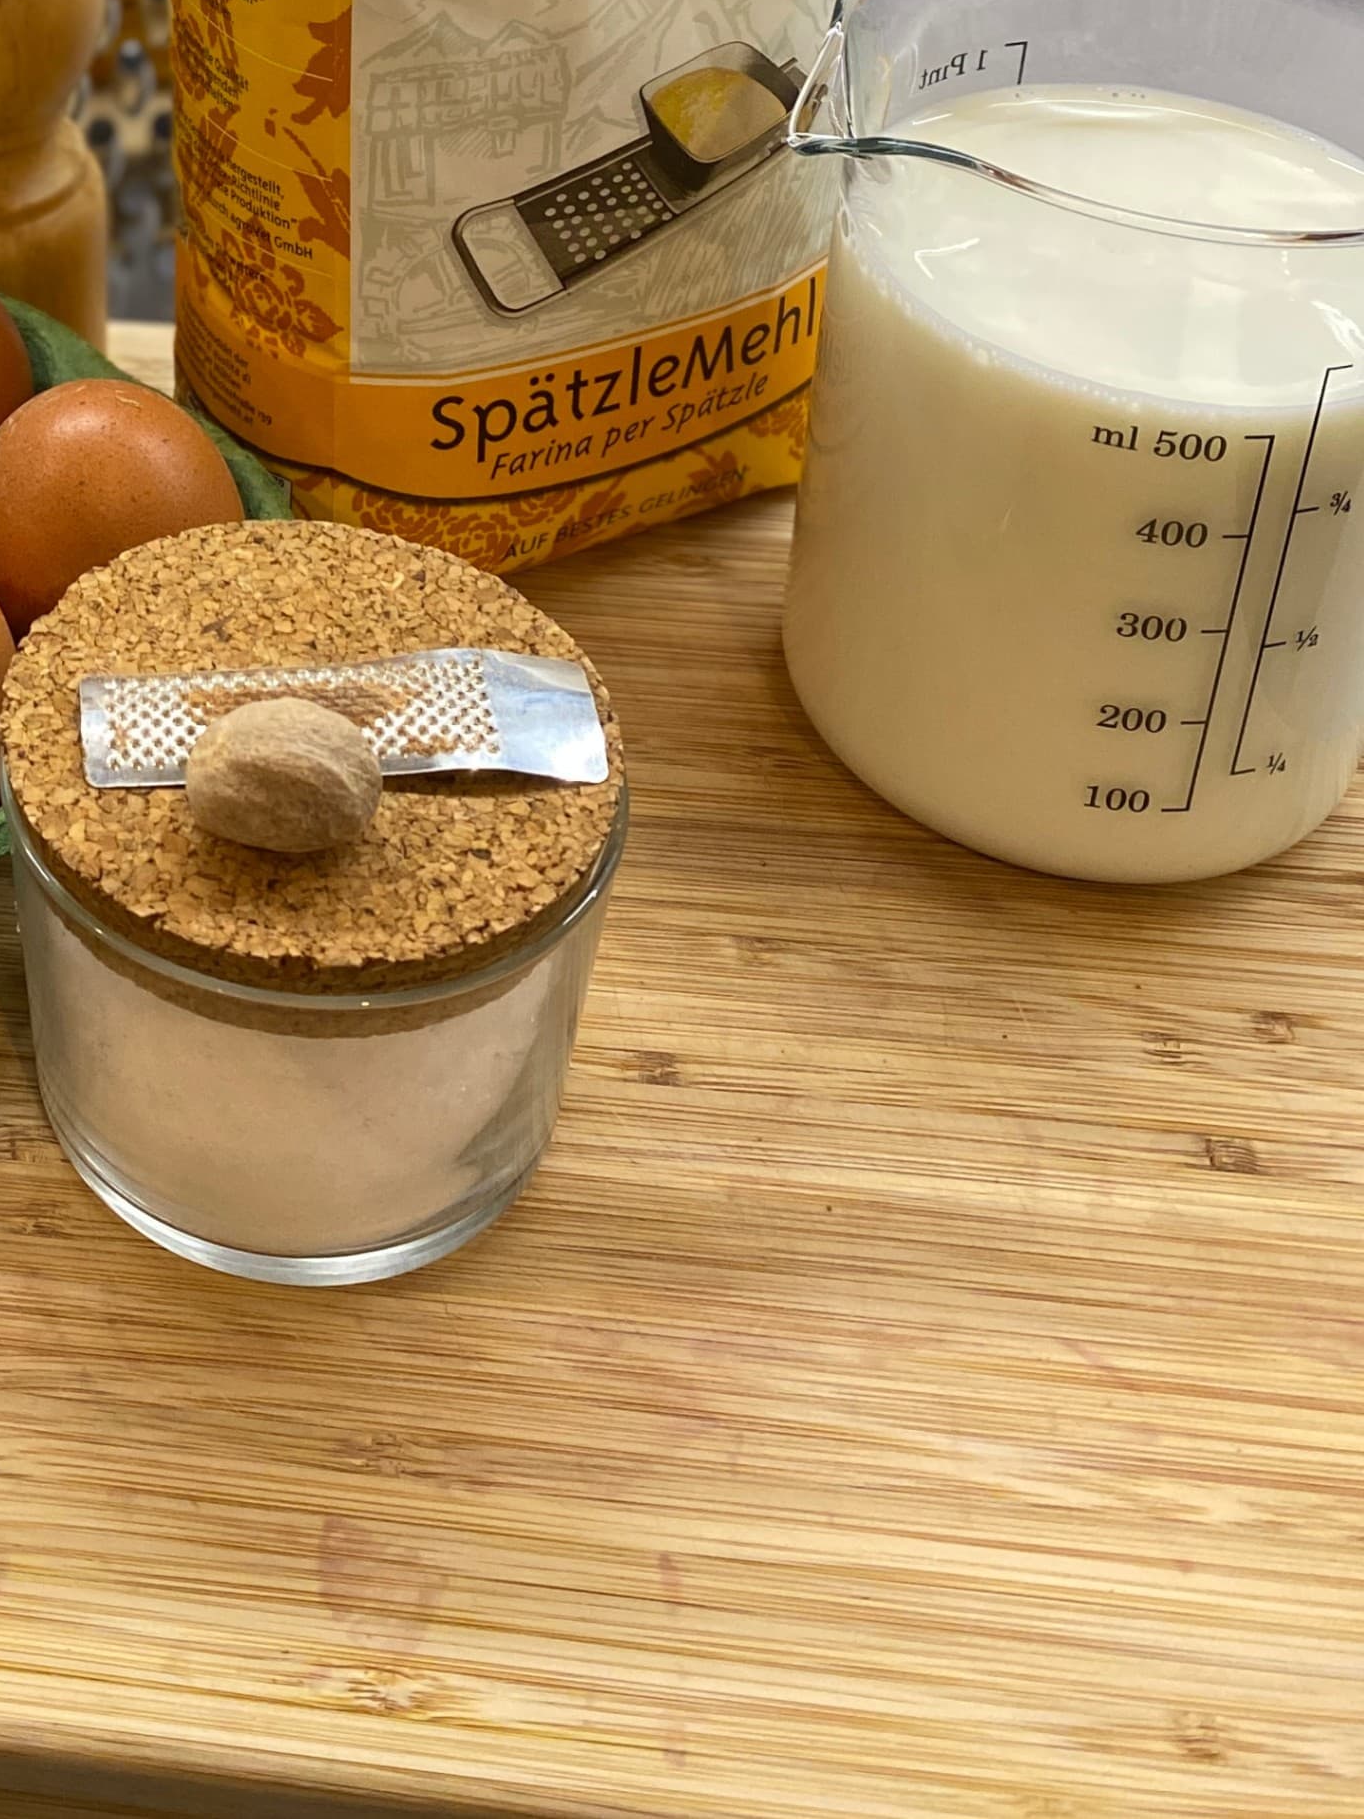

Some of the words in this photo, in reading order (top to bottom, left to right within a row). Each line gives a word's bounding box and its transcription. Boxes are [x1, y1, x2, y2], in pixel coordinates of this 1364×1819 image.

[273, 235, 314, 261] GmbH
[430, 277, 817, 463] SpätzleMehl
[490, 435, 592, 480] Farina
[601, 414, 653, 458] per
[660, 371, 769, 435] Spätzle
[1090, 425, 1138, 451] ml
[1153, 430, 1227, 462] 500
[503, 532, 549, 560] AUF
[555, 503, 632, 544] BESTES
[1135, 519, 1209, 548] 400
[1116, 613, 1188, 642] 300
[1096, 704, 1167, 734] 200
[1083, 785, 1151, 814] 100
